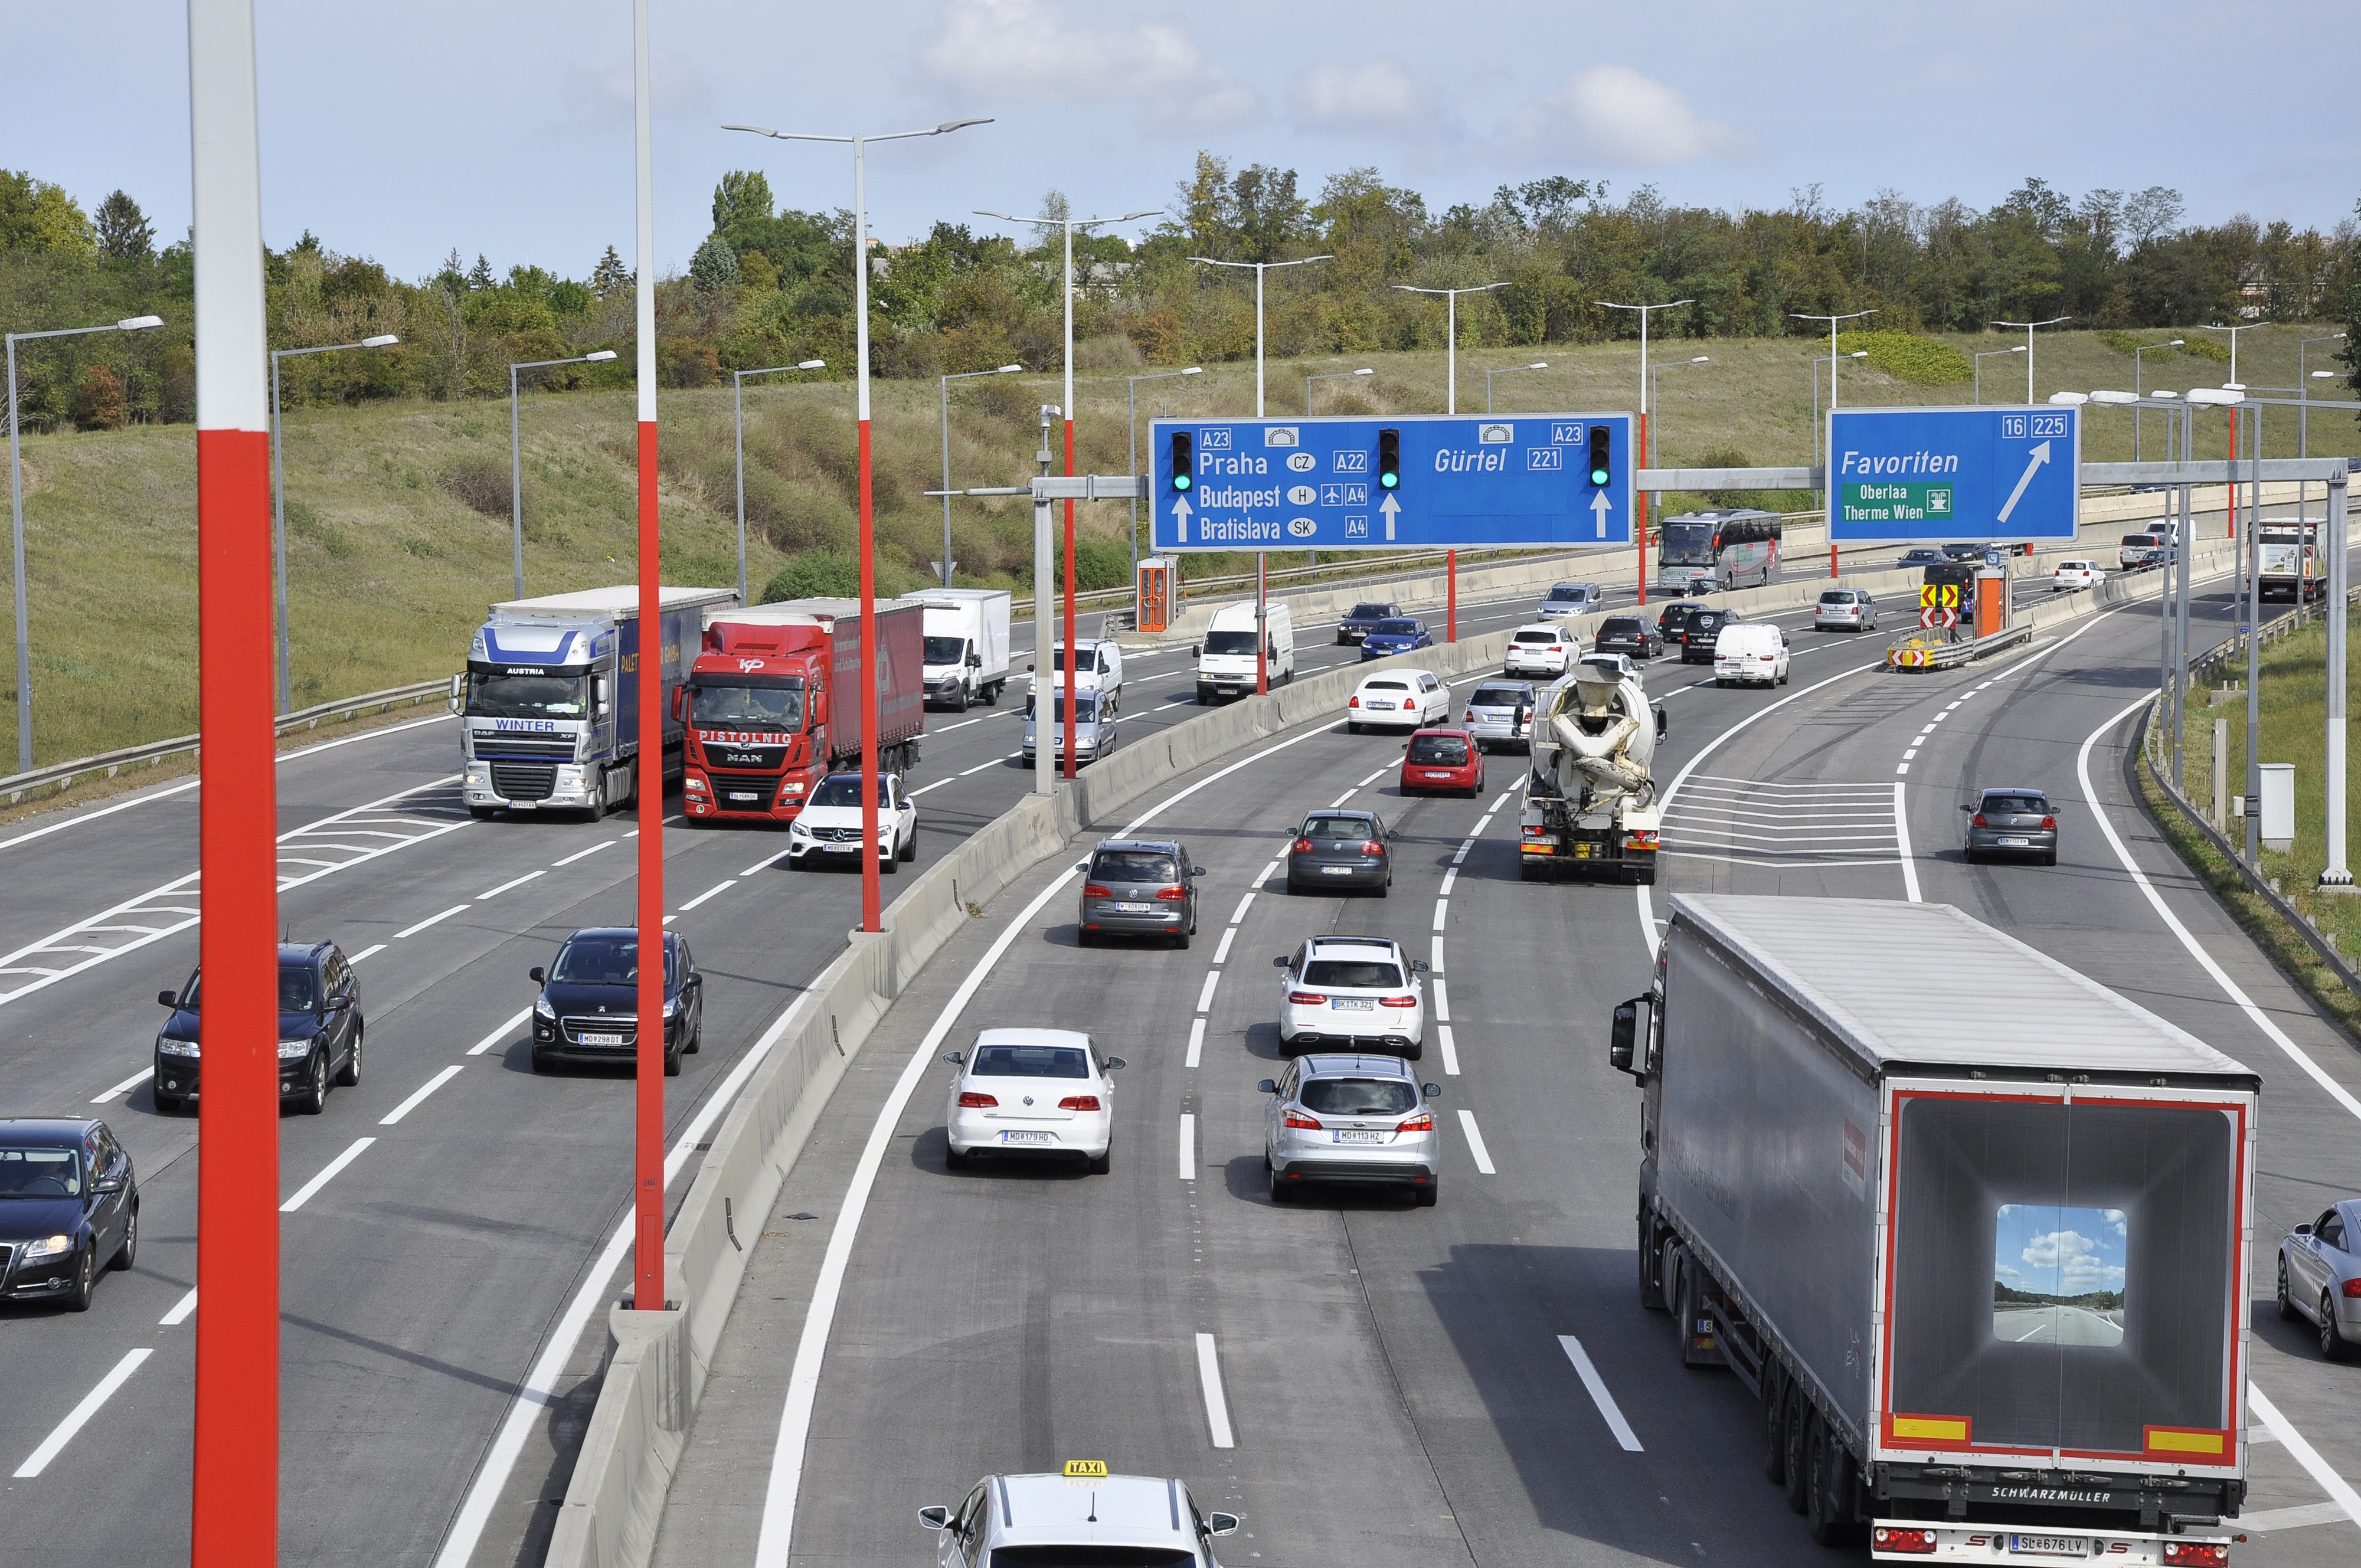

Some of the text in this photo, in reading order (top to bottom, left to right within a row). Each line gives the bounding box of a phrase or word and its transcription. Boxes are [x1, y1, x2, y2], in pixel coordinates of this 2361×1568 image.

[1554, 426, 1581, 442] A23
[2006, 418, 2064, 436] 16 225
[1202, 431, 1229, 447] A23
[1200, 452, 1364, 475] Praha CZ A22
[1434, 448, 1558, 472] Gürtel 221
[1841, 450, 1959, 474] Favoriten
[1200, 485, 1365, 513] Budapest H A4
[1860, 484, 1907, 500] Oberlaa
[1844, 505, 1924, 521] Therme Wien
[1201, 517, 1365, 540] Bratislava SK A4
[621, 652, 640, 673] PALET
[496, 719, 554, 731] WINTER
[699, 730, 792, 744] PISTOLNIG
[727, 754, 763, 762] MAN
[1025, 1132, 1038, 1141] 179
[1039, 1133, 1048, 1141] HD
[1341, 1131, 1380, 1140] MD 113 HZ
[1071, 1462, 1101, 1473] TAXI
[1992, 1486, 2111, 1502] SCHWARZMÜLLER
[2022, 1537, 2035, 1549] SL
[2043, 1538, 2065, 1551] 676
[2068, 1539, 2082, 1551] LV
